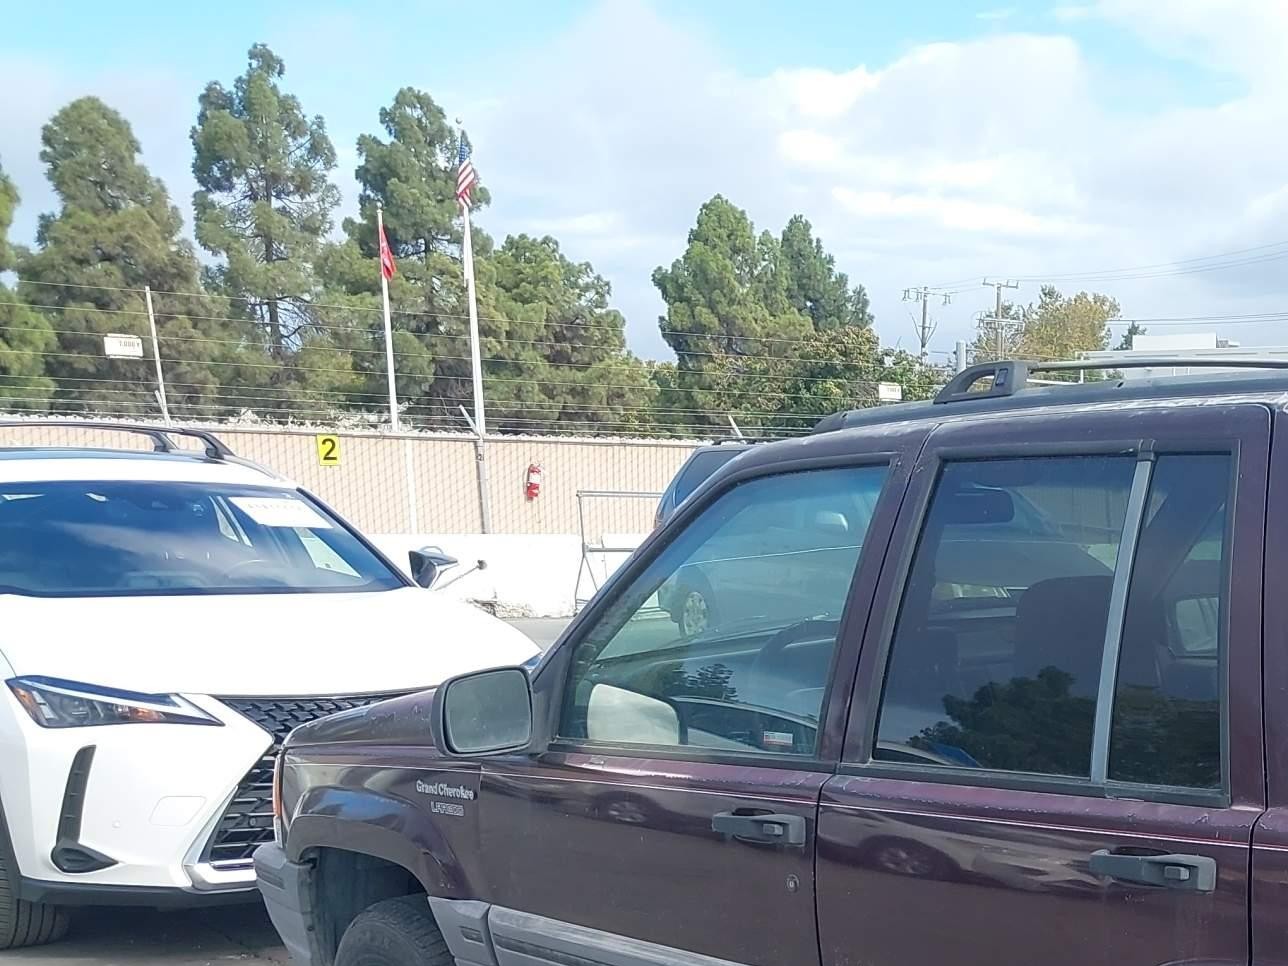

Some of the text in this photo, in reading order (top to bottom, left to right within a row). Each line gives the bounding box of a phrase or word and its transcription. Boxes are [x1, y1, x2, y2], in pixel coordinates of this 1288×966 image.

[321, 438, 338, 461] 2
[416, 779, 474, 801] Grand Cherokee
